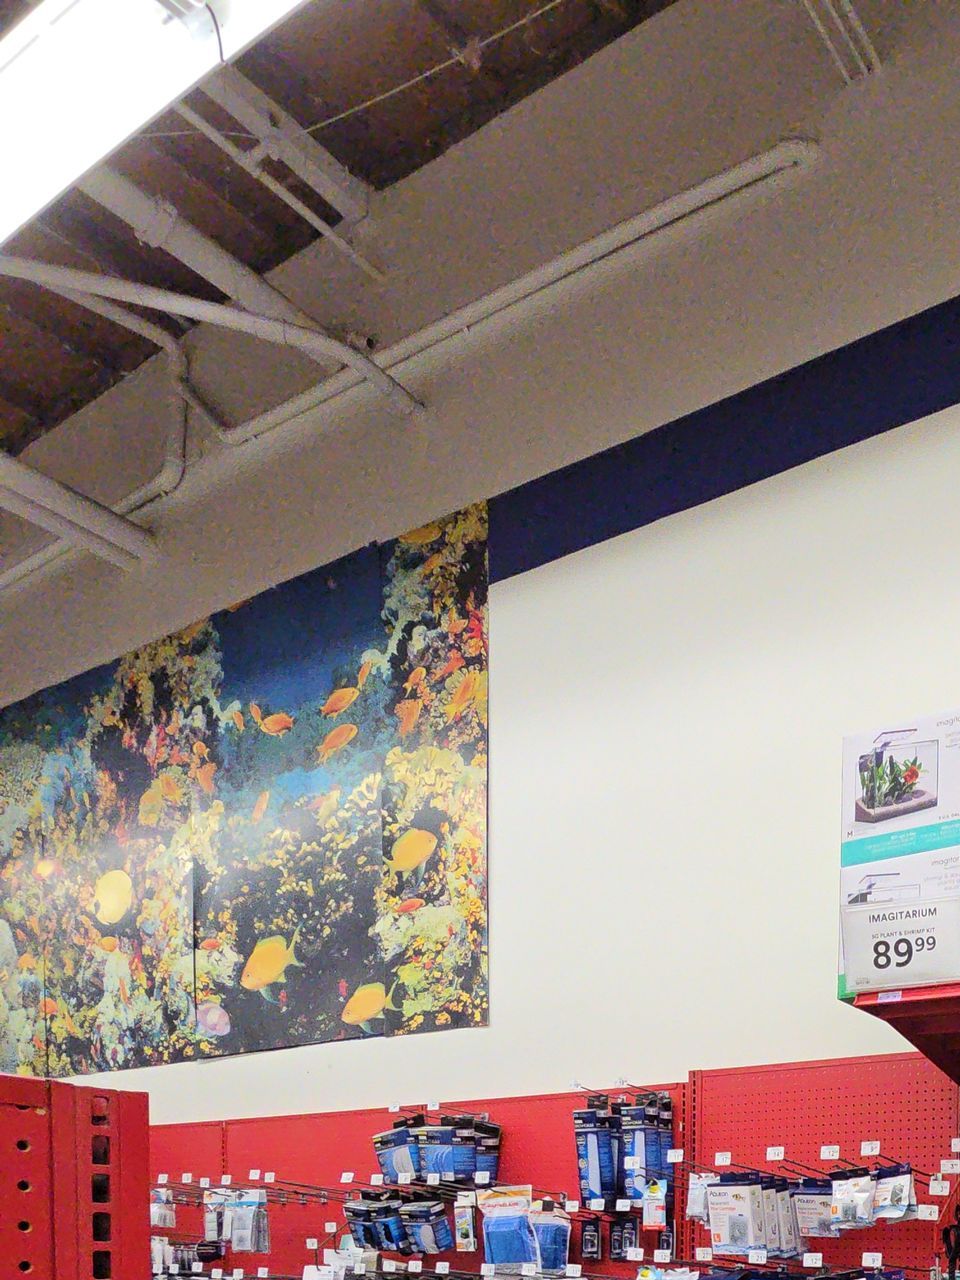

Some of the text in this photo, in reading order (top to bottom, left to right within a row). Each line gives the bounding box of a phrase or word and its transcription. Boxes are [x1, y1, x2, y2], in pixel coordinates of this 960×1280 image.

[869, 907, 937, 924] IMAGITARIUM
[880, 931, 897, 939] PLANT
[904, 928, 926, 936] SHRIMP
